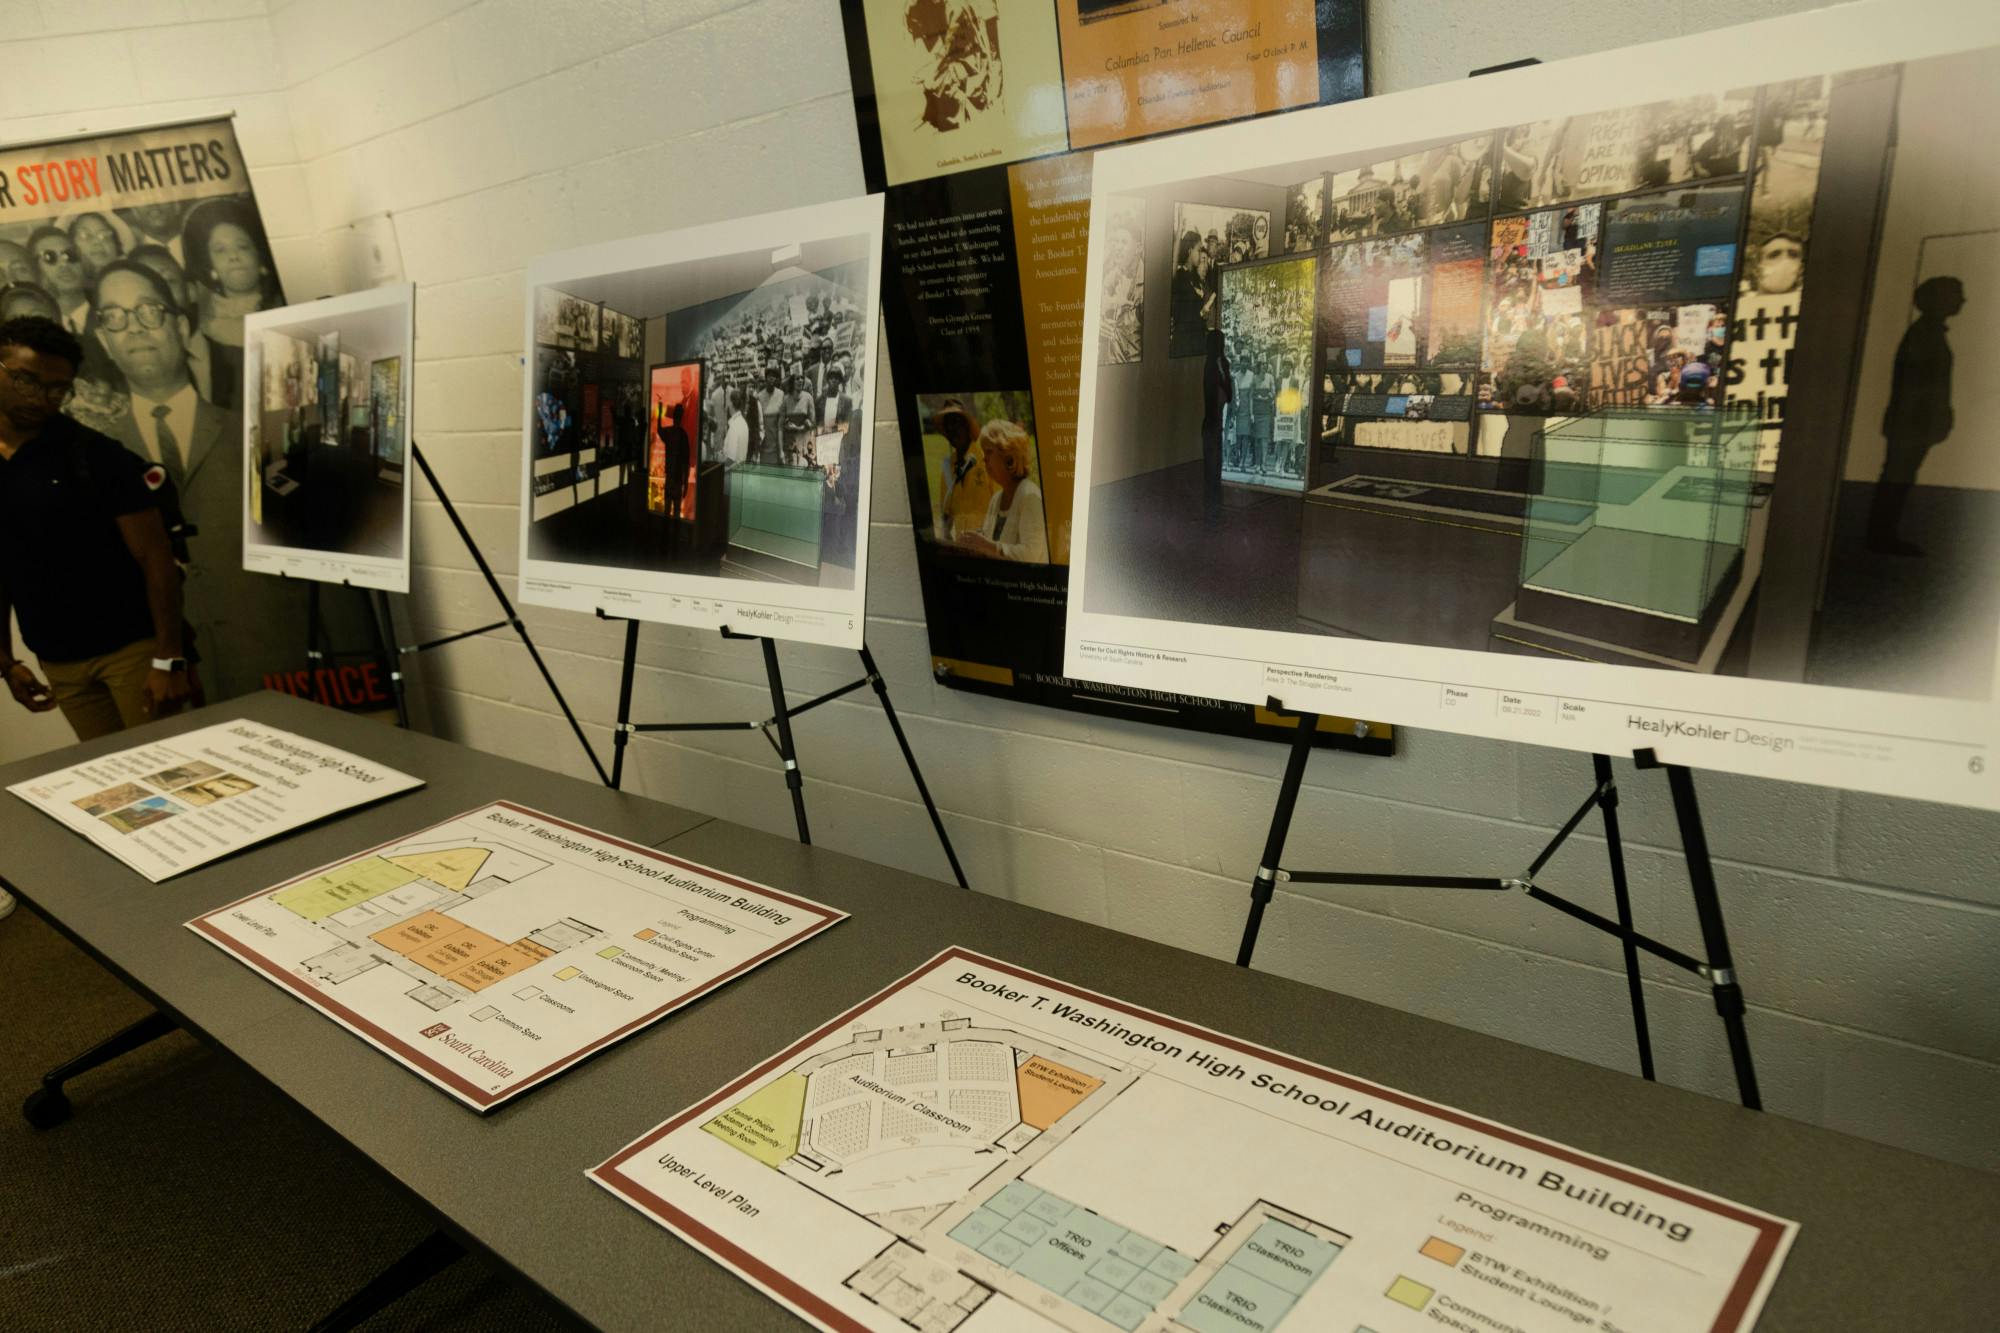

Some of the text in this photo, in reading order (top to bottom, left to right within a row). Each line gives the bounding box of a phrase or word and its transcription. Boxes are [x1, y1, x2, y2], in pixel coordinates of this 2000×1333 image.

[1158, 15, 1199, 31] Sponsored by
[1105, 21, 1261, 72] Columbia Pan Hellenic Council
[1585, 143, 1616, 162] ARE
[16, 156, 101, 207] STORY
[106, 138, 232, 195] MATTERS
[1043, 209, 1082, 226] leadership
[1032, 226, 1076, 245] alumni and
[1047, 247, 1074, 260] Booker
[1038, 302, 1053, 313] The
[1041, 319, 1078, 330] memories
[1046, 368, 1072, 381] School
[1589, 356, 1649, 388] LIVES
[737, 606, 773, 622] HealyKohler
[773, 611, 794, 625] Design
[848, 619, 854, 631] 5
[1105, 647, 1117, 655] Civil
[1117, 648, 1135, 658] Rights
[1136, 650, 1155, 660] History
[1155, 653, 1161, 661] &
[1162, 654, 1188, 664] Research
[1266, 666, 1339, 684] Perspective Rendering
[1036, 672, 1073, 689] BOOKER
[1081, 680, 1147, 700] WASHINGTON
[1148, 690, 1177, 704] HIGH
[1178, 693, 1225, 711] SCHOOL
[1229, 701, 1246, 713] 1974
[1446, 688, 1469, 699] Phase
[1503, 695, 1522, 705] Date
[1562, 702, 1586, 713] Scale
[1626, 714, 1732, 743] HealyKohler
[1734, 726, 1796, 753] Design
[338, 763, 385, 785] School
[1967, 754, 1985, 775] 6
[486, 812, 793, 926] Booker T. Washington High School Auditorium Building
[262, 925, 279, 939] Plan
[677, 909, 737, 935] Programming
[648, 938, 701, 963] Exhibition Space
[658, 933, 717, 960] Civil Rights Center
[611, 957, 665, 984] Classroom Space
[621, 951, 688, 984] Community Meeting
[578, 973, 635, 1002] Unassigned Space
[539, 992, 576, 1015] Classrooms
[495, 1013, 543, 1042] Common Space
[438, 1032, 516, 1080] South Carolina
[1023, 1067, 1085, 1096] Student Lounge
[1028, 1060, 1089, 1088] BTW Exhibition
[732, 1107, 755, 1122] Fannie
[849, 1074, 907, 1105] Auditorium
[912, 1102, 973, 1134] Classroom
[955, 971, 1695, 1244] Booker T. Washington High School Auditorium Building
[713, 1118, 758, 1147] Meeting Room
[722, 1113, 781, 1148] Adams Community
[657, 1153, 761, 1218] Upper Level Plan
[1063, 1229, 1093, 1248] TRIO
[1454, 1191, 1612, 1262] Programming
[1047, 1236, 1087, 1262] Offices
[1246, 1241, 1314, 1278] Classroom
[1273, 1238, 1306, 1259] TRIO
[1469, 1250, 1602, 1312] BTW Exhibition
[1224, 1290, 1258, 1313] TRIO
[1460, 1262, 1597, 1327] Student Lounge
[1197, 1293, 1265, 1333] Classroom
